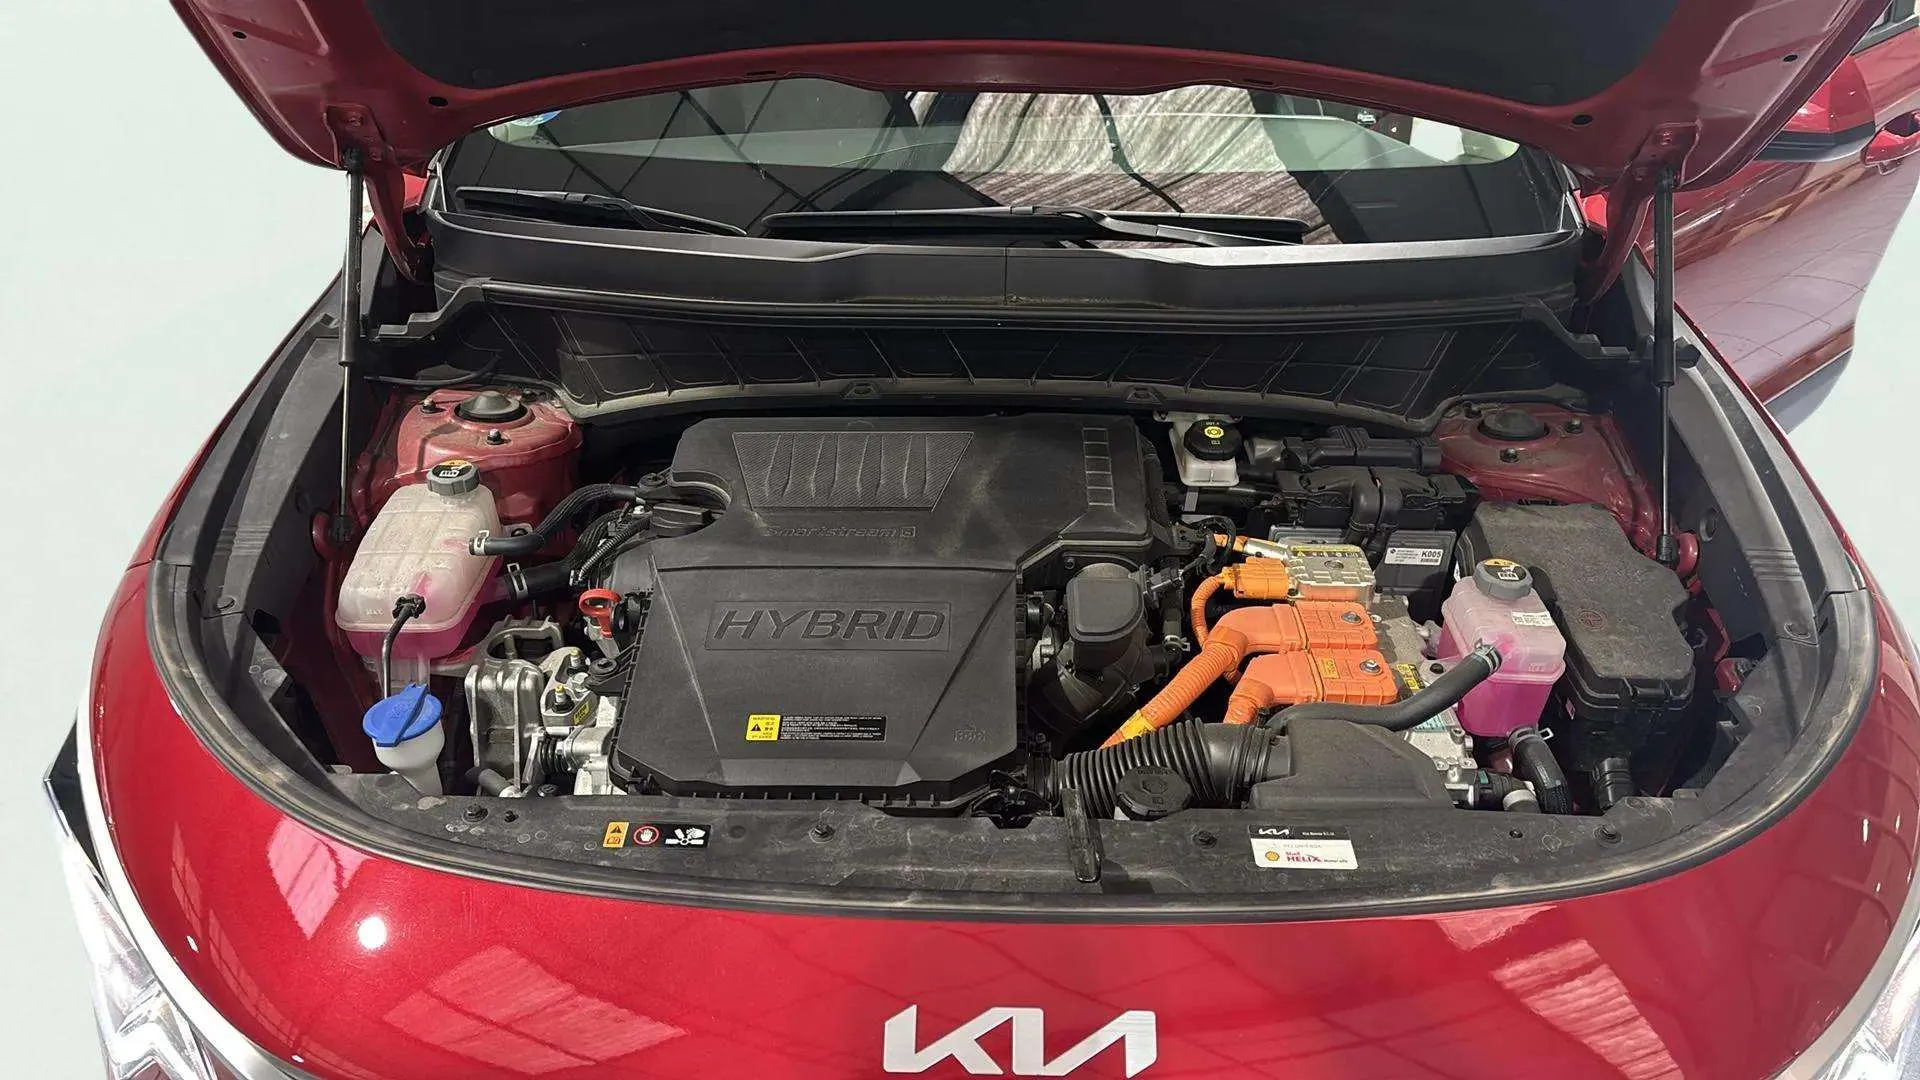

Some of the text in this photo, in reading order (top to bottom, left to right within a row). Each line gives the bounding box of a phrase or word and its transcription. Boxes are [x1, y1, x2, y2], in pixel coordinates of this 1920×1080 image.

[764, 526, 897, 537] Smartstream
[1421, 550, 1441, 558] K005
[713, 609, 946, 640] HYBRID
[1286, 855, 1322, 863] HELIX
[883, 1003, 1157, 1079] KIA
